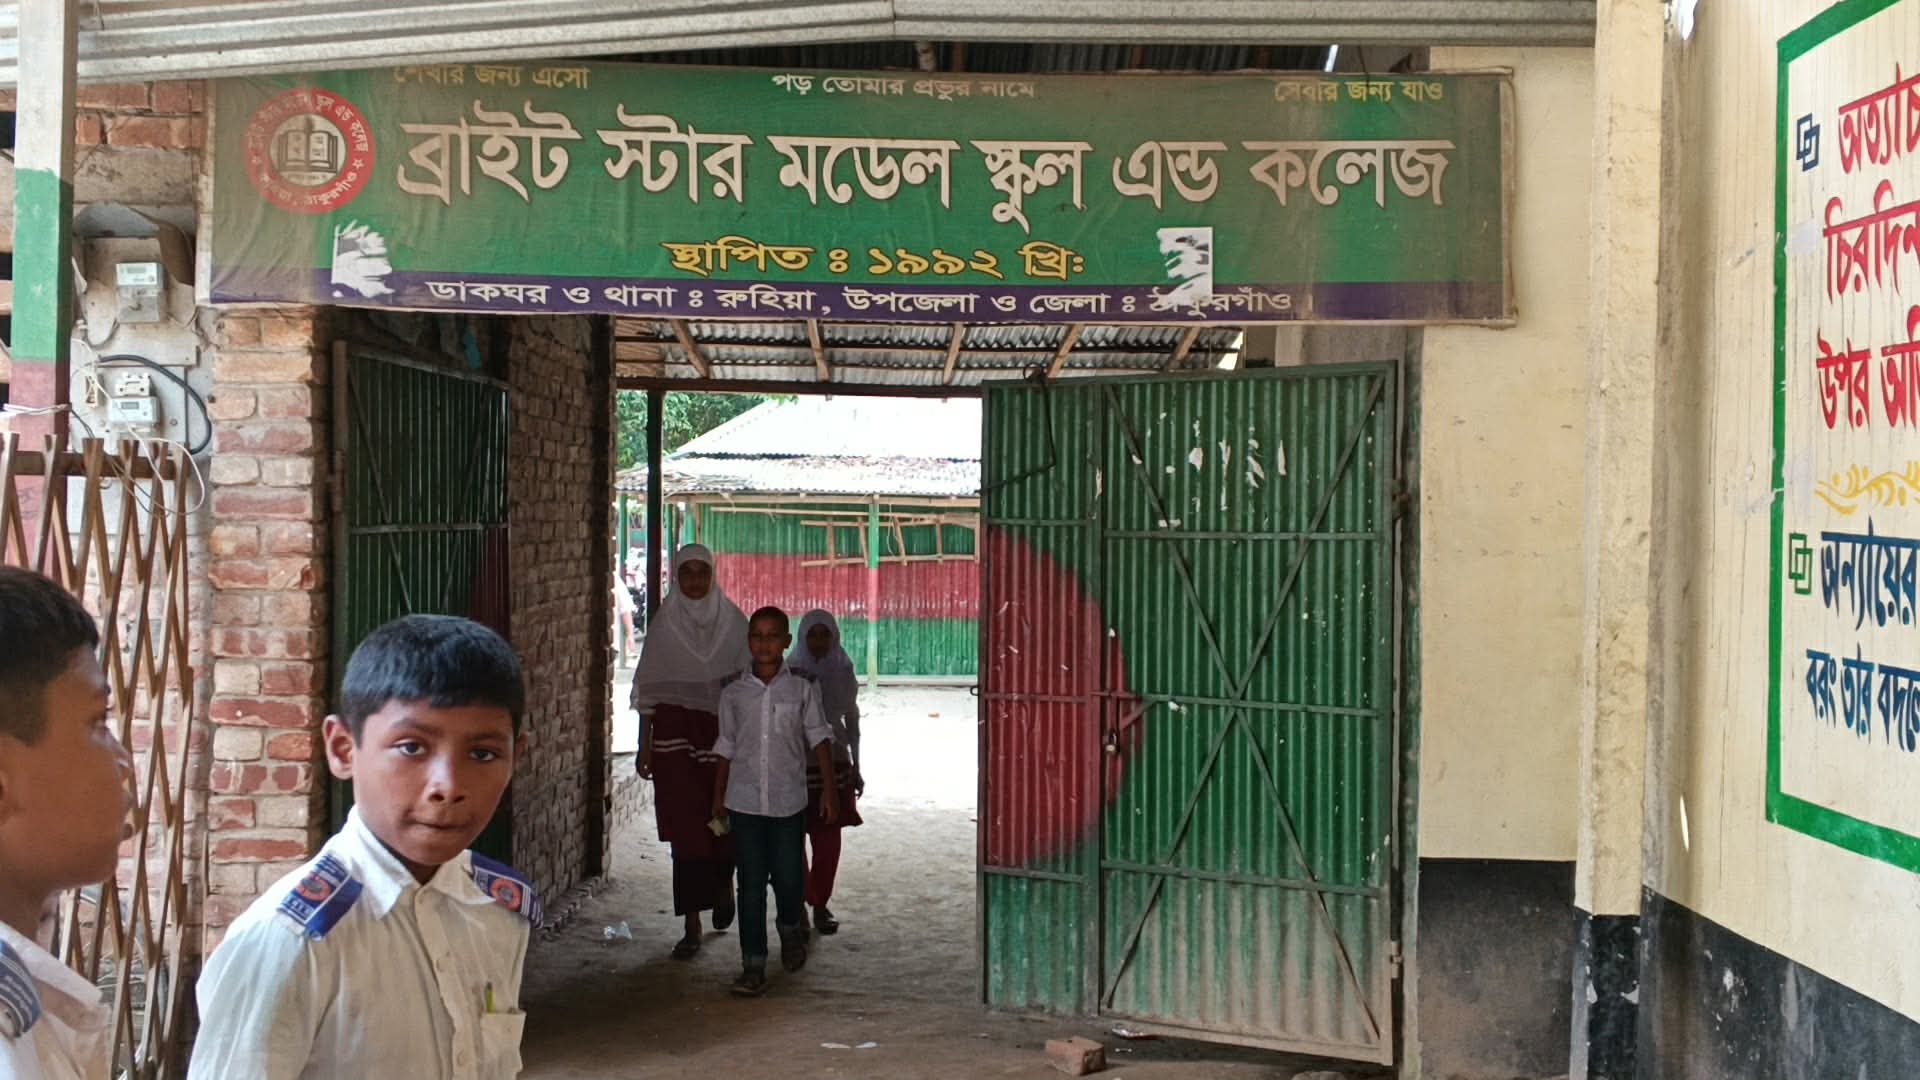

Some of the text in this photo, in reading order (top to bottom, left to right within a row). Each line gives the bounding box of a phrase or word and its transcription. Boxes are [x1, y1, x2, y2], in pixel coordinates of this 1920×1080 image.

[474, 64, 525, 87] জন্য
[532, 66, 592, 90] এসো
[772, 73, 1038, 102] পড় তোমার প্রভুর নামে
[1344, 80, 1395, 102] জন্য
[1400, 80, 1444, 102] যাও
[396, 98, 584, 208] ব্রাইট
[595, 103, 755, 205] স্টার
[765, 135, 962, 210] মডেল
[968, 139, 1095, 236] স্কুল
[1111, 139, 1229, 210] এন্ড
[1240, 139, 1457, 209] কলেজ
[661, 234, 816, 277] স্থাপিত
[867, 247, 1005, 280] ১৯৯২
[424, 280, 552, 306] ডাকঘর
[562, 286, 592, 303] ও
[603, 285, 678, 309] থানা
[841, 286, 981, 315] উপজেলা
[990, 294, 1018, 312] ও
[1028, 291, 1112, 315] জেলা
[1815, 327, 1872, 433] উপর
[1805, 648, 1837, 729] বরং
[1840, 640, 1875, 745] তার
